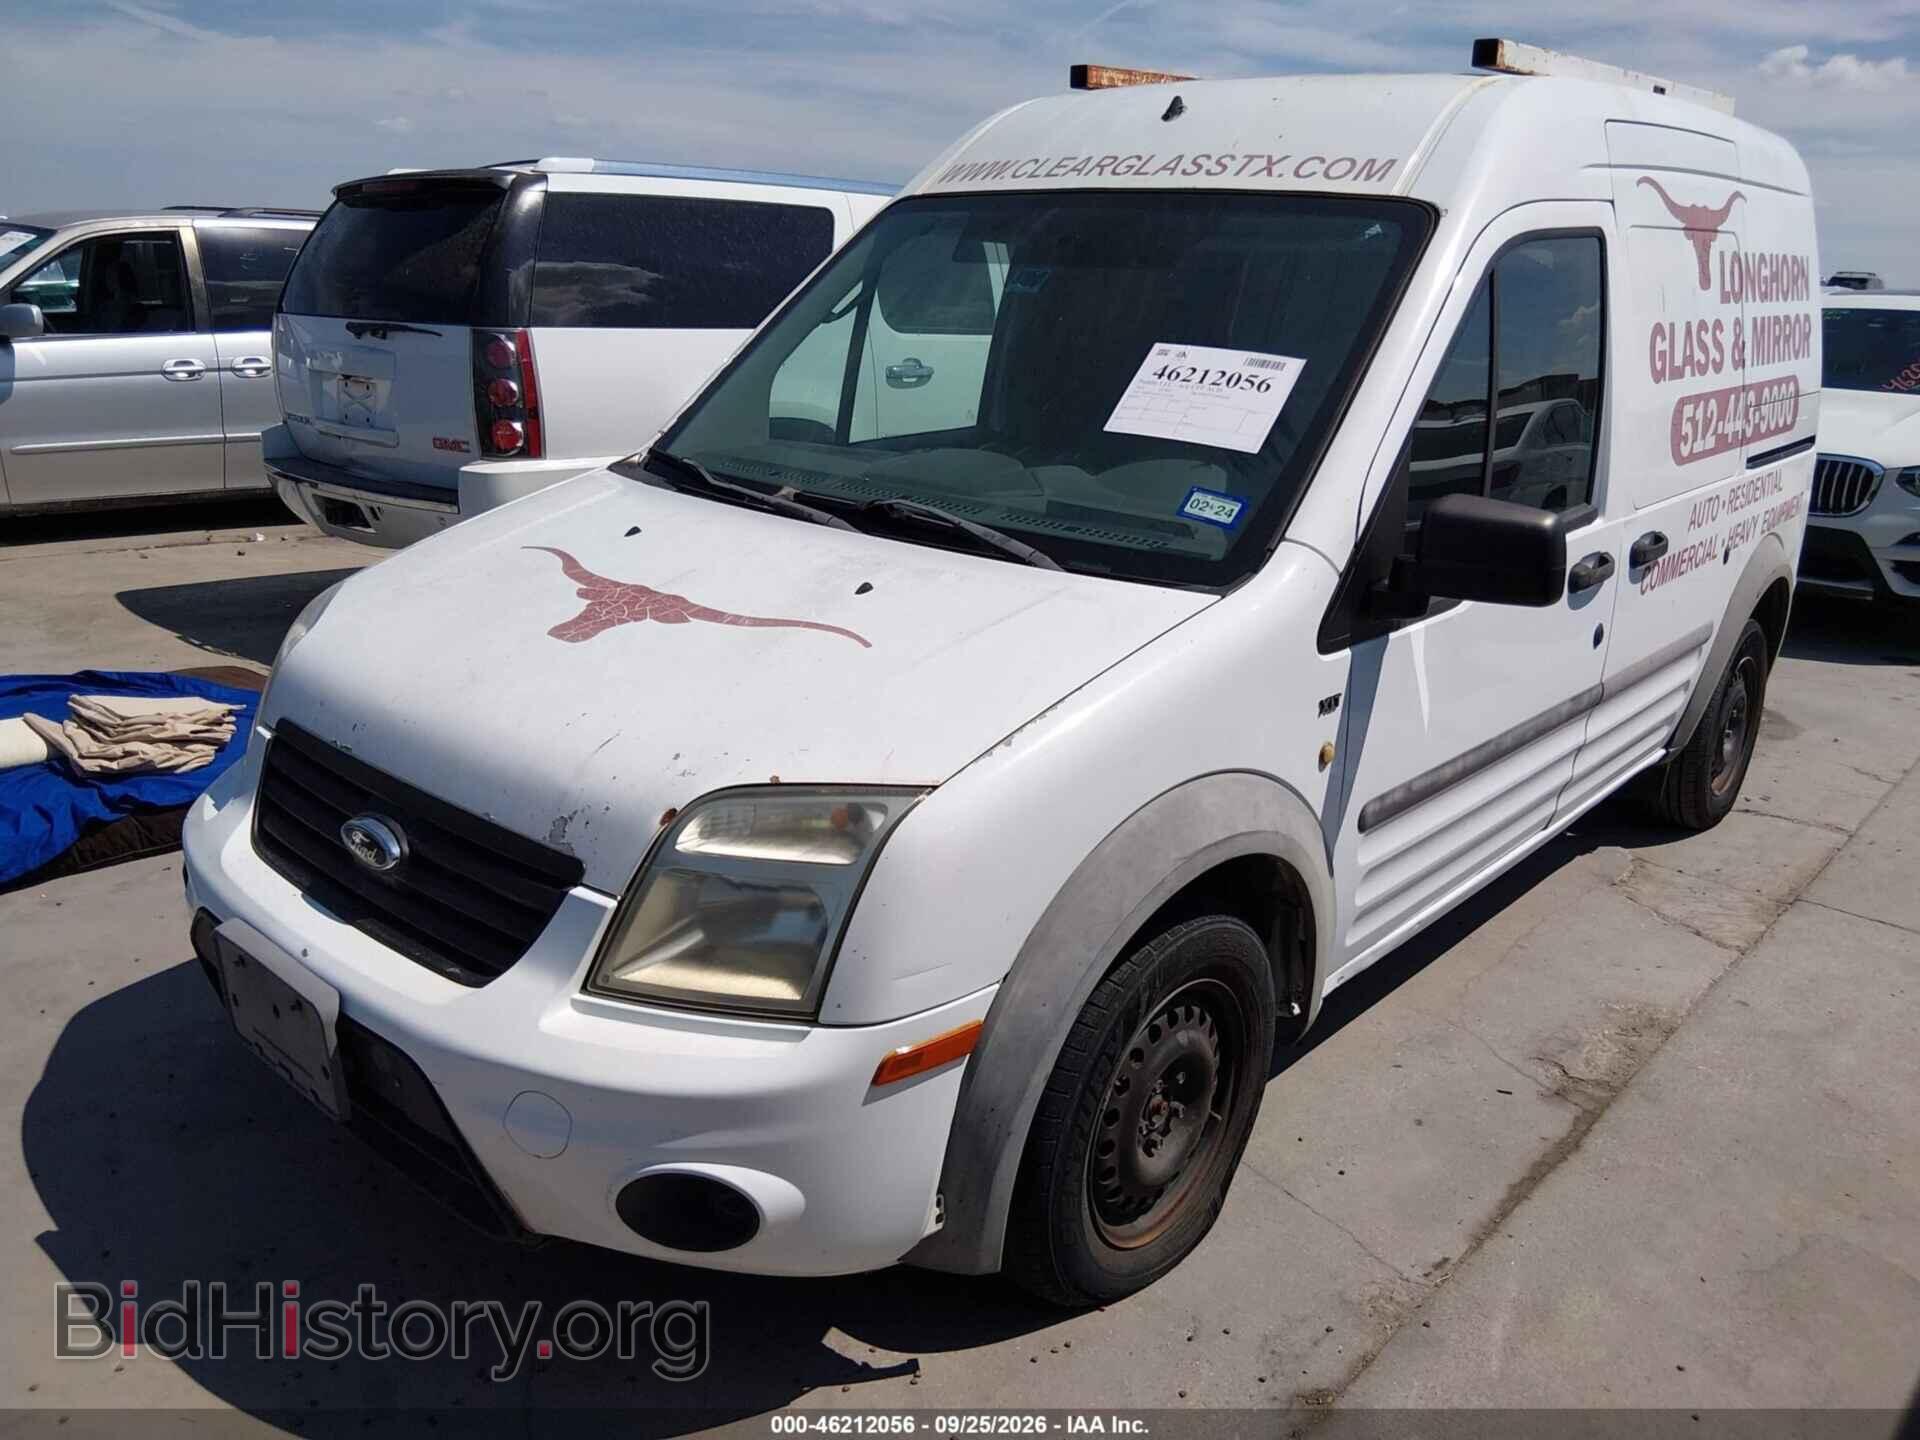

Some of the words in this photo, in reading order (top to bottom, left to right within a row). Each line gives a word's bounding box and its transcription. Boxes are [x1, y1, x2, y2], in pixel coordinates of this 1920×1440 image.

[938, 153, 1398, 184] WWW.CLEARGLASSTX.COM
[1719, 250, 1810, 305] LONGHORN
[1153, 363, 1276, 394] 46212056
[1649, 318, 1725, 384] GLASS
[1731, 316, 1745, 371] &
[1750, 313, 1812, 368] MIRROR
[1687, 494, 1720, 534] AUTO
[1726, 469, 1784, 515] RESIDENTIAL
[1640, 534, 1719, 596] COMMERCIAL
[1725, 513, 1760, 553] HEAVY
